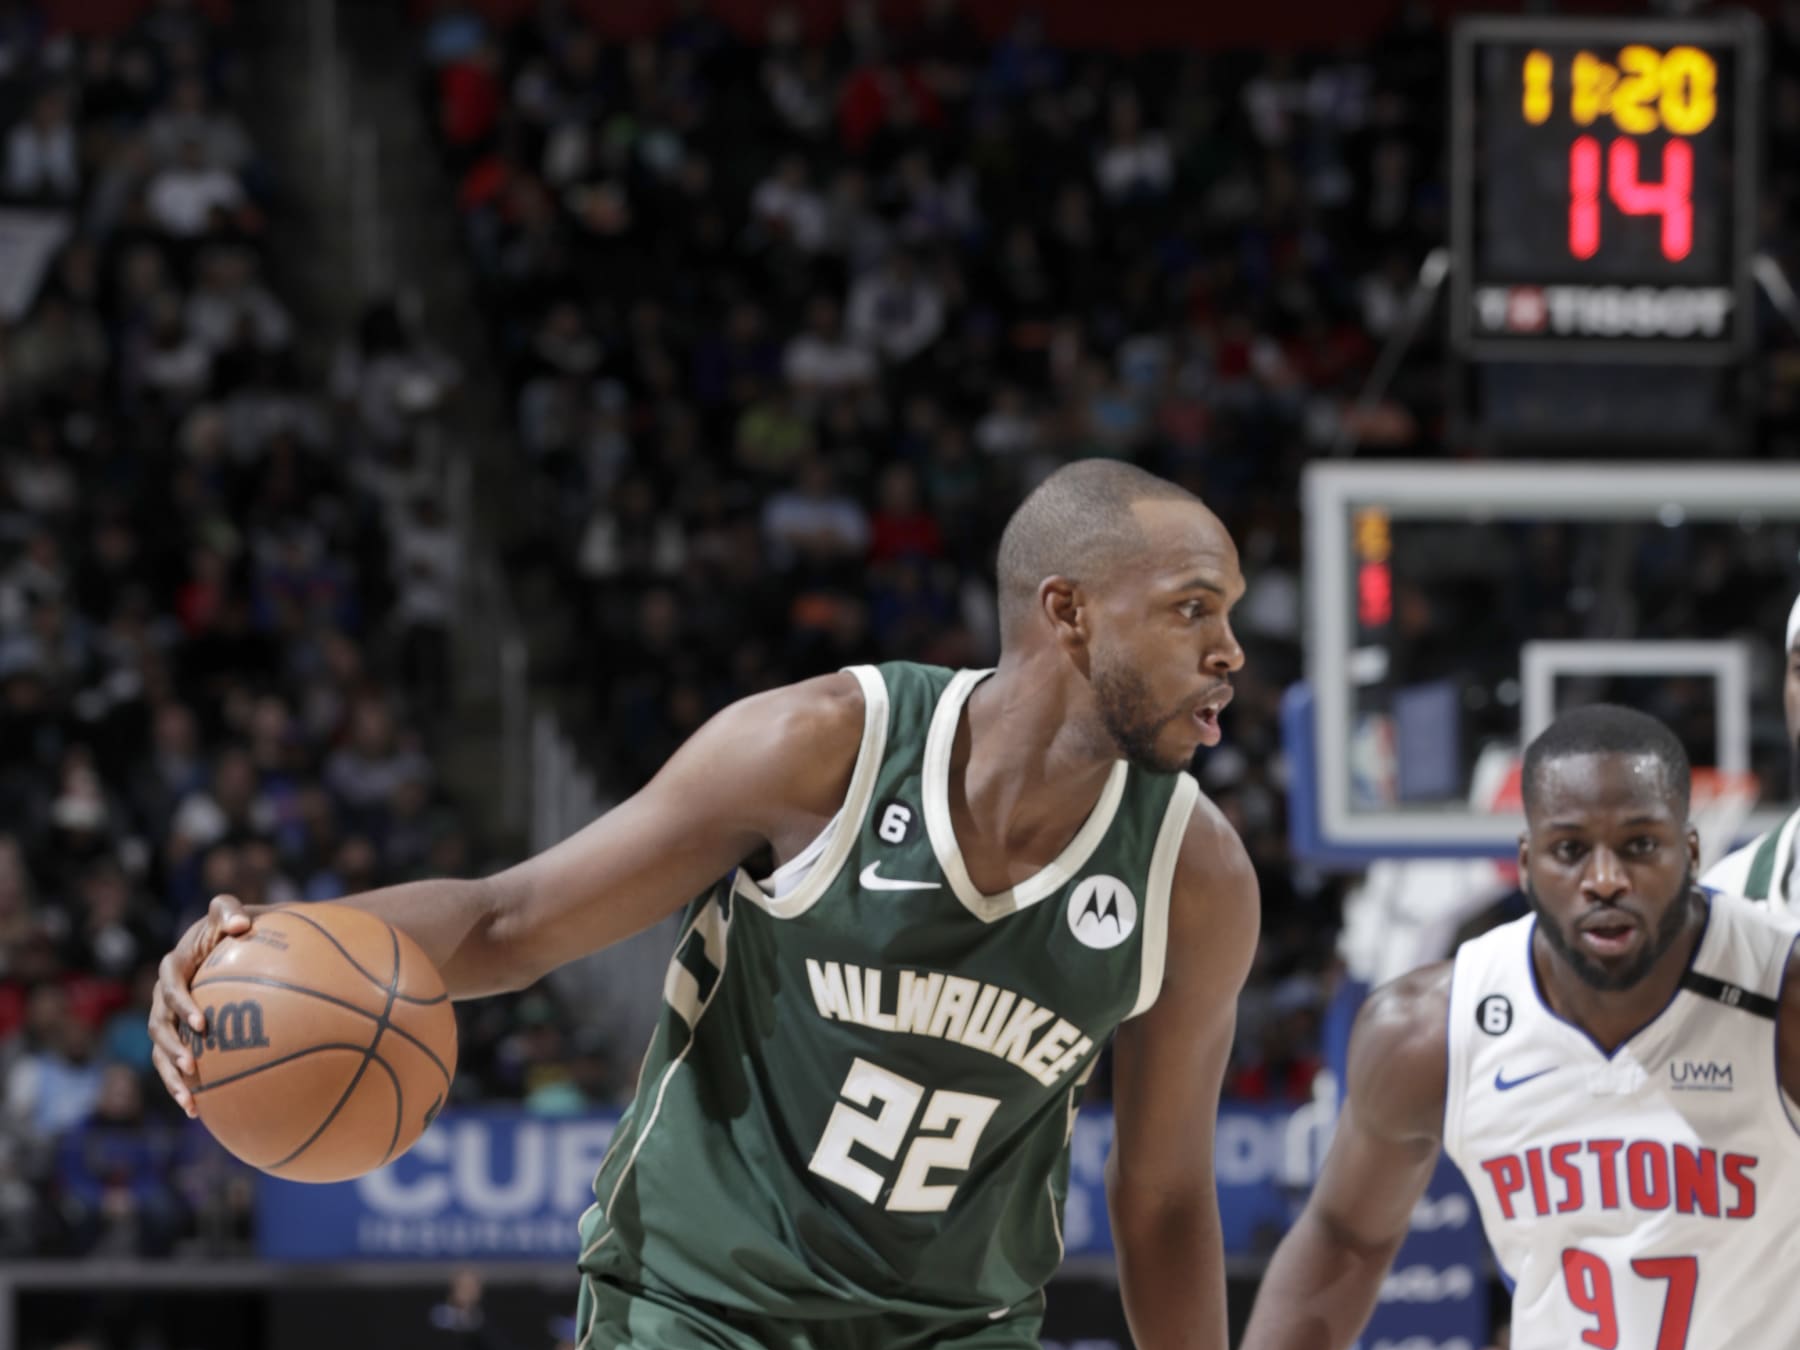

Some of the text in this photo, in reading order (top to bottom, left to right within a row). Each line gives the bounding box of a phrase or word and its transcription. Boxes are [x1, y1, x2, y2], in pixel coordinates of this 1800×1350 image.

[1569, 135, 1694, 262] 14
[1548, 285, 1731, 337] TISSOT
[879, 803, 911, 844] 6
[1483, 996, 1509, 1033] 6
[1670, 1061, 1733, 1084] UWM
[808, 1056, 1001, 1212] 22
[1480, 1139, 1758, 1220] PISTONS
